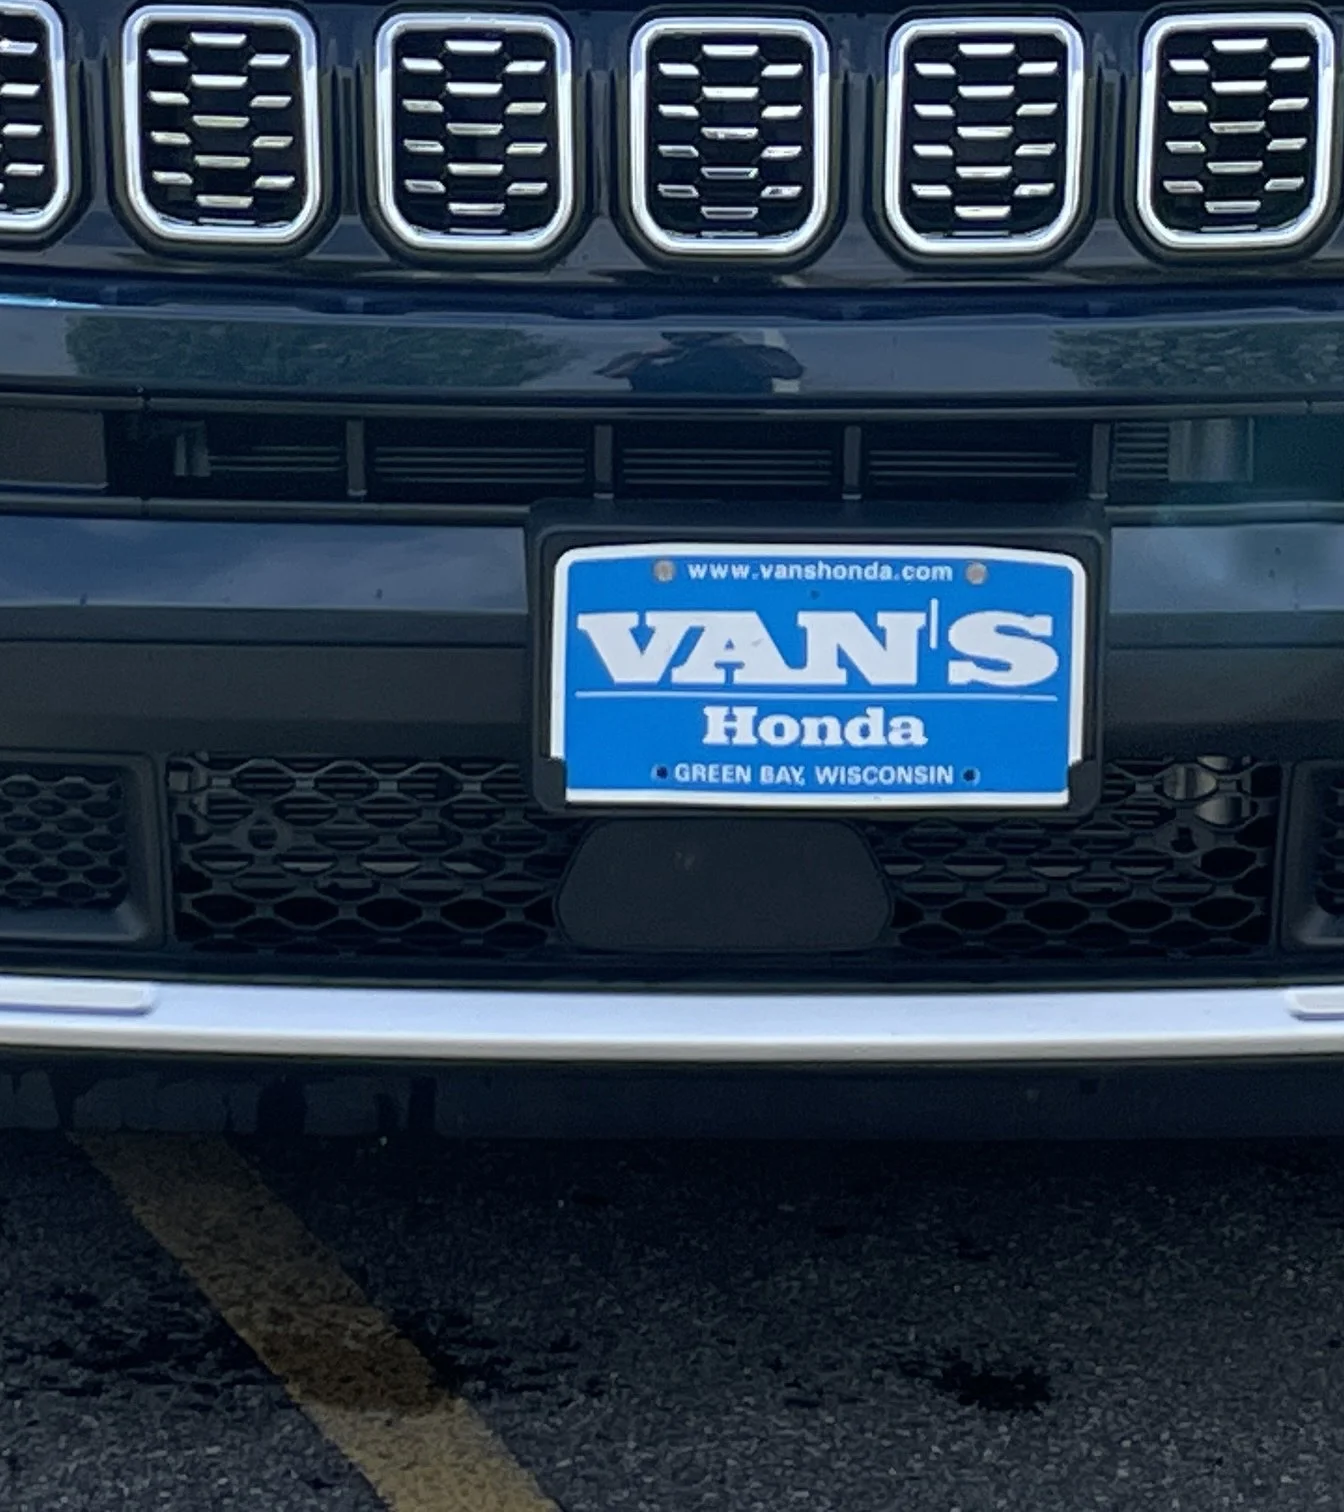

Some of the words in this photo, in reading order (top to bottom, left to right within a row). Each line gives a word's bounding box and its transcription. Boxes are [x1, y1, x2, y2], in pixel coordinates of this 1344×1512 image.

[688, 561, 954, 583] www.vanshonda.com
[576, 598, 1060, 688] VAN'S
[702, 705, 929, 748] Honda
[674, 763, 751, 784] GREEN
[816, 764, 954, 786] WISCONSIN
